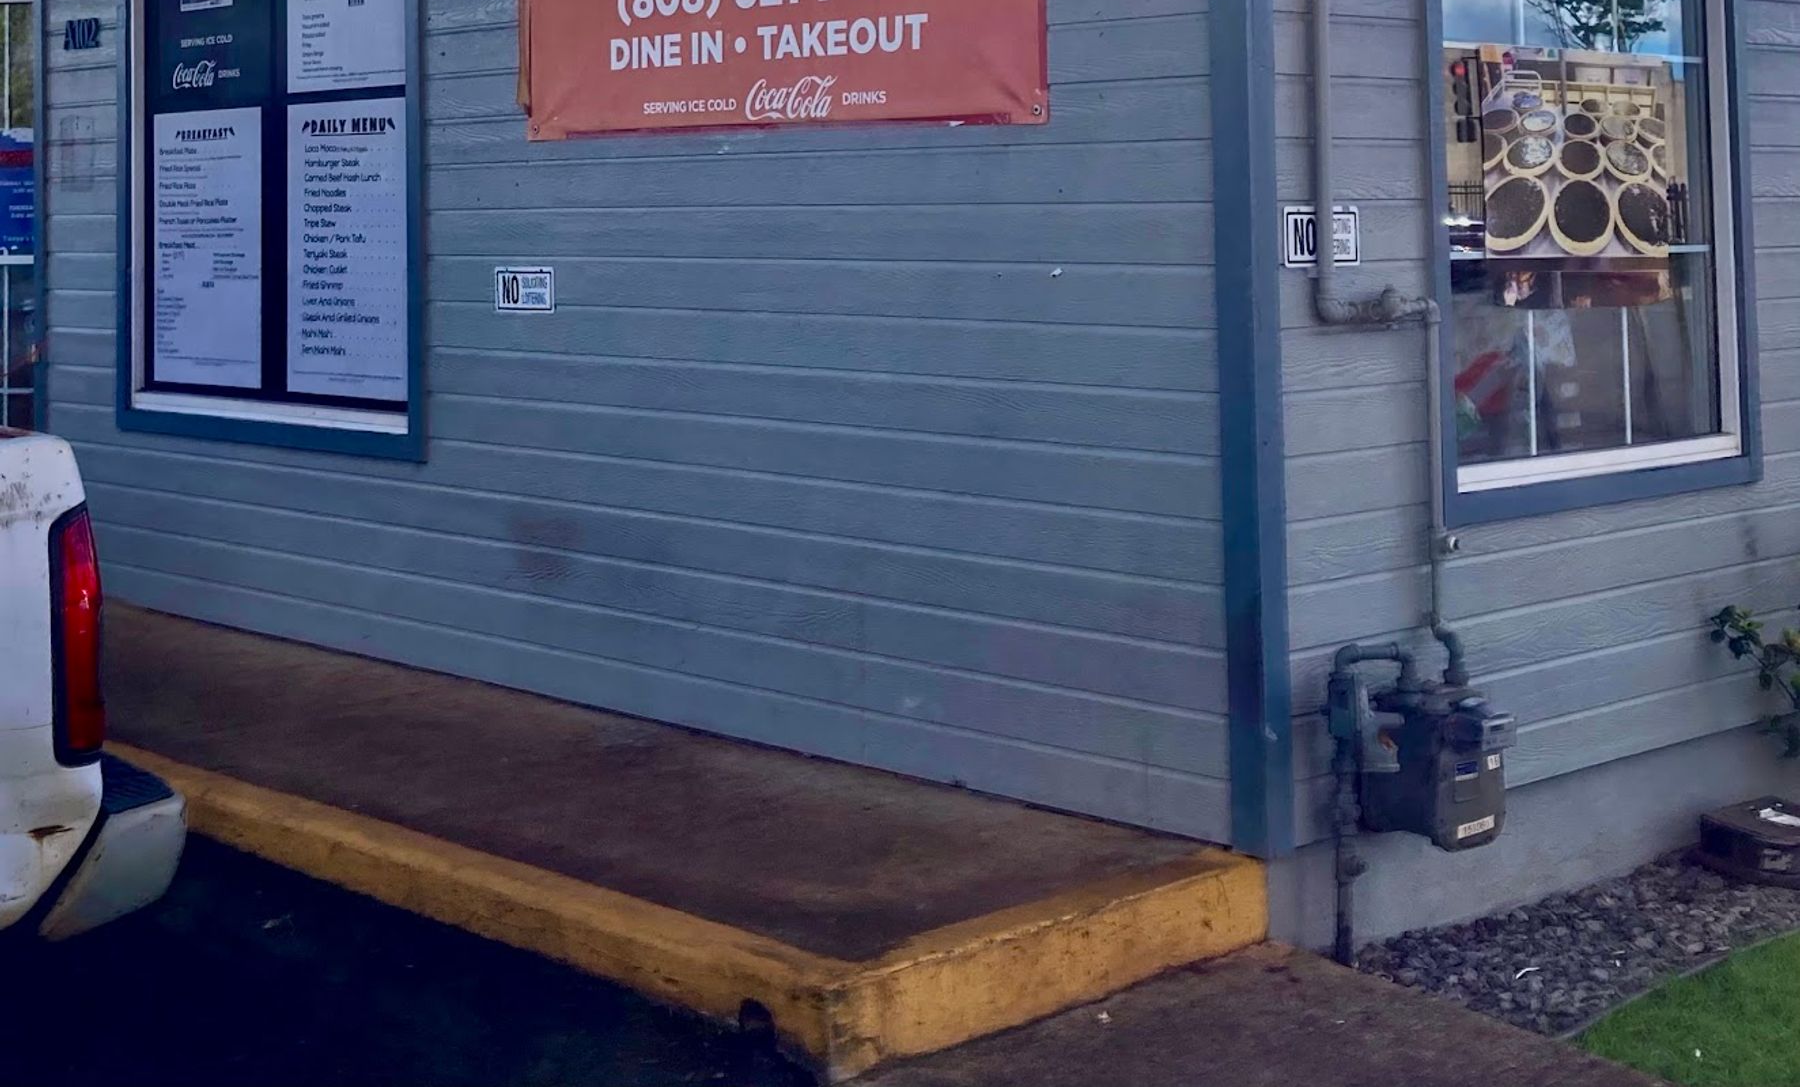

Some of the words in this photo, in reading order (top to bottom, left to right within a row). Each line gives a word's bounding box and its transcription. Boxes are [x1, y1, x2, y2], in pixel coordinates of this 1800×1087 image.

[64, 18, 100, 50] A102
[216, 34, 233, 44] COLD
[610, 31, 682, 70] DINE
[691, 30, 723, 65] IN
[757, 13, 928, 60] TAKEOUT
[643, 100, 687, 114] SERVING
[688, 100, 705, 112] ICE
[707, 98, 736, 111] COLD
[842, 90, 886, 105] DRINKS
[311, 119, 346, 133] DAILY
[351, 117, 386, 132] MENU
[1294, 218, 1317, 256] NO
[502, 275, 519, 304] NO
